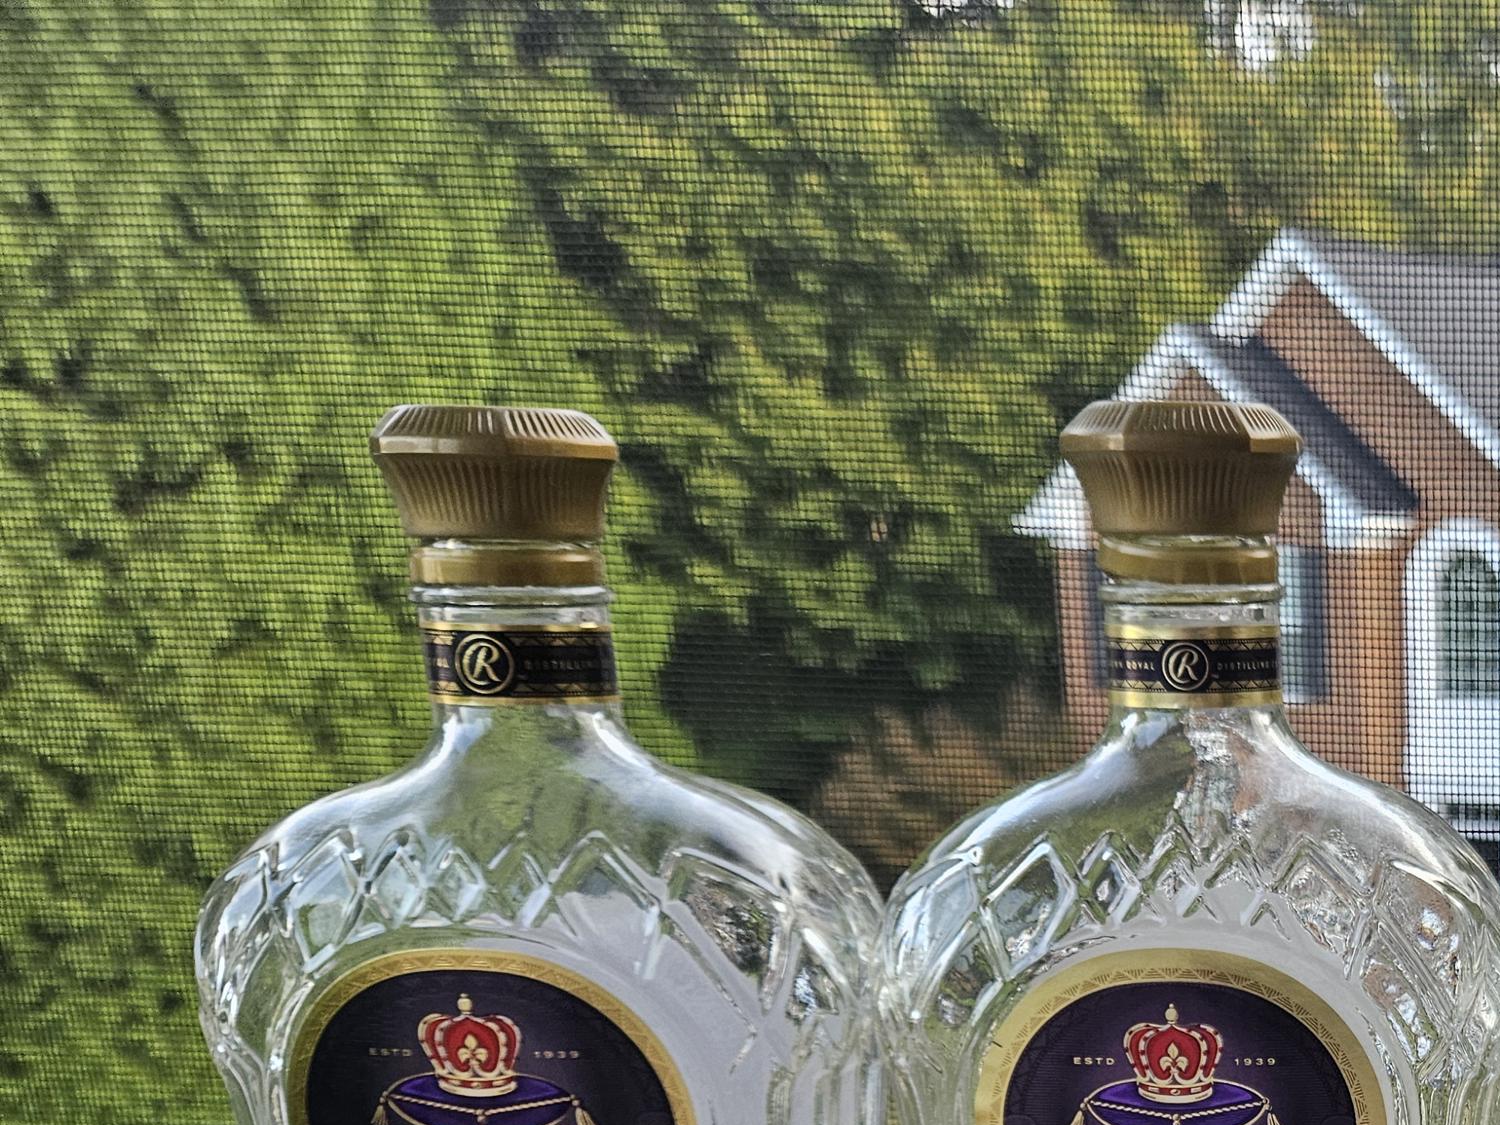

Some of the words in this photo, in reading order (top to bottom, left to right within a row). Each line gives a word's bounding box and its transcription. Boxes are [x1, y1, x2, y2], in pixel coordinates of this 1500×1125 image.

[368, 1047, 414, 1057] ESTD
[533, 1050, 580, 1060] 1939
[1073, 1057, 1115, 1066] ESTD
[1234, 1057, 1276, 1066] 1939
